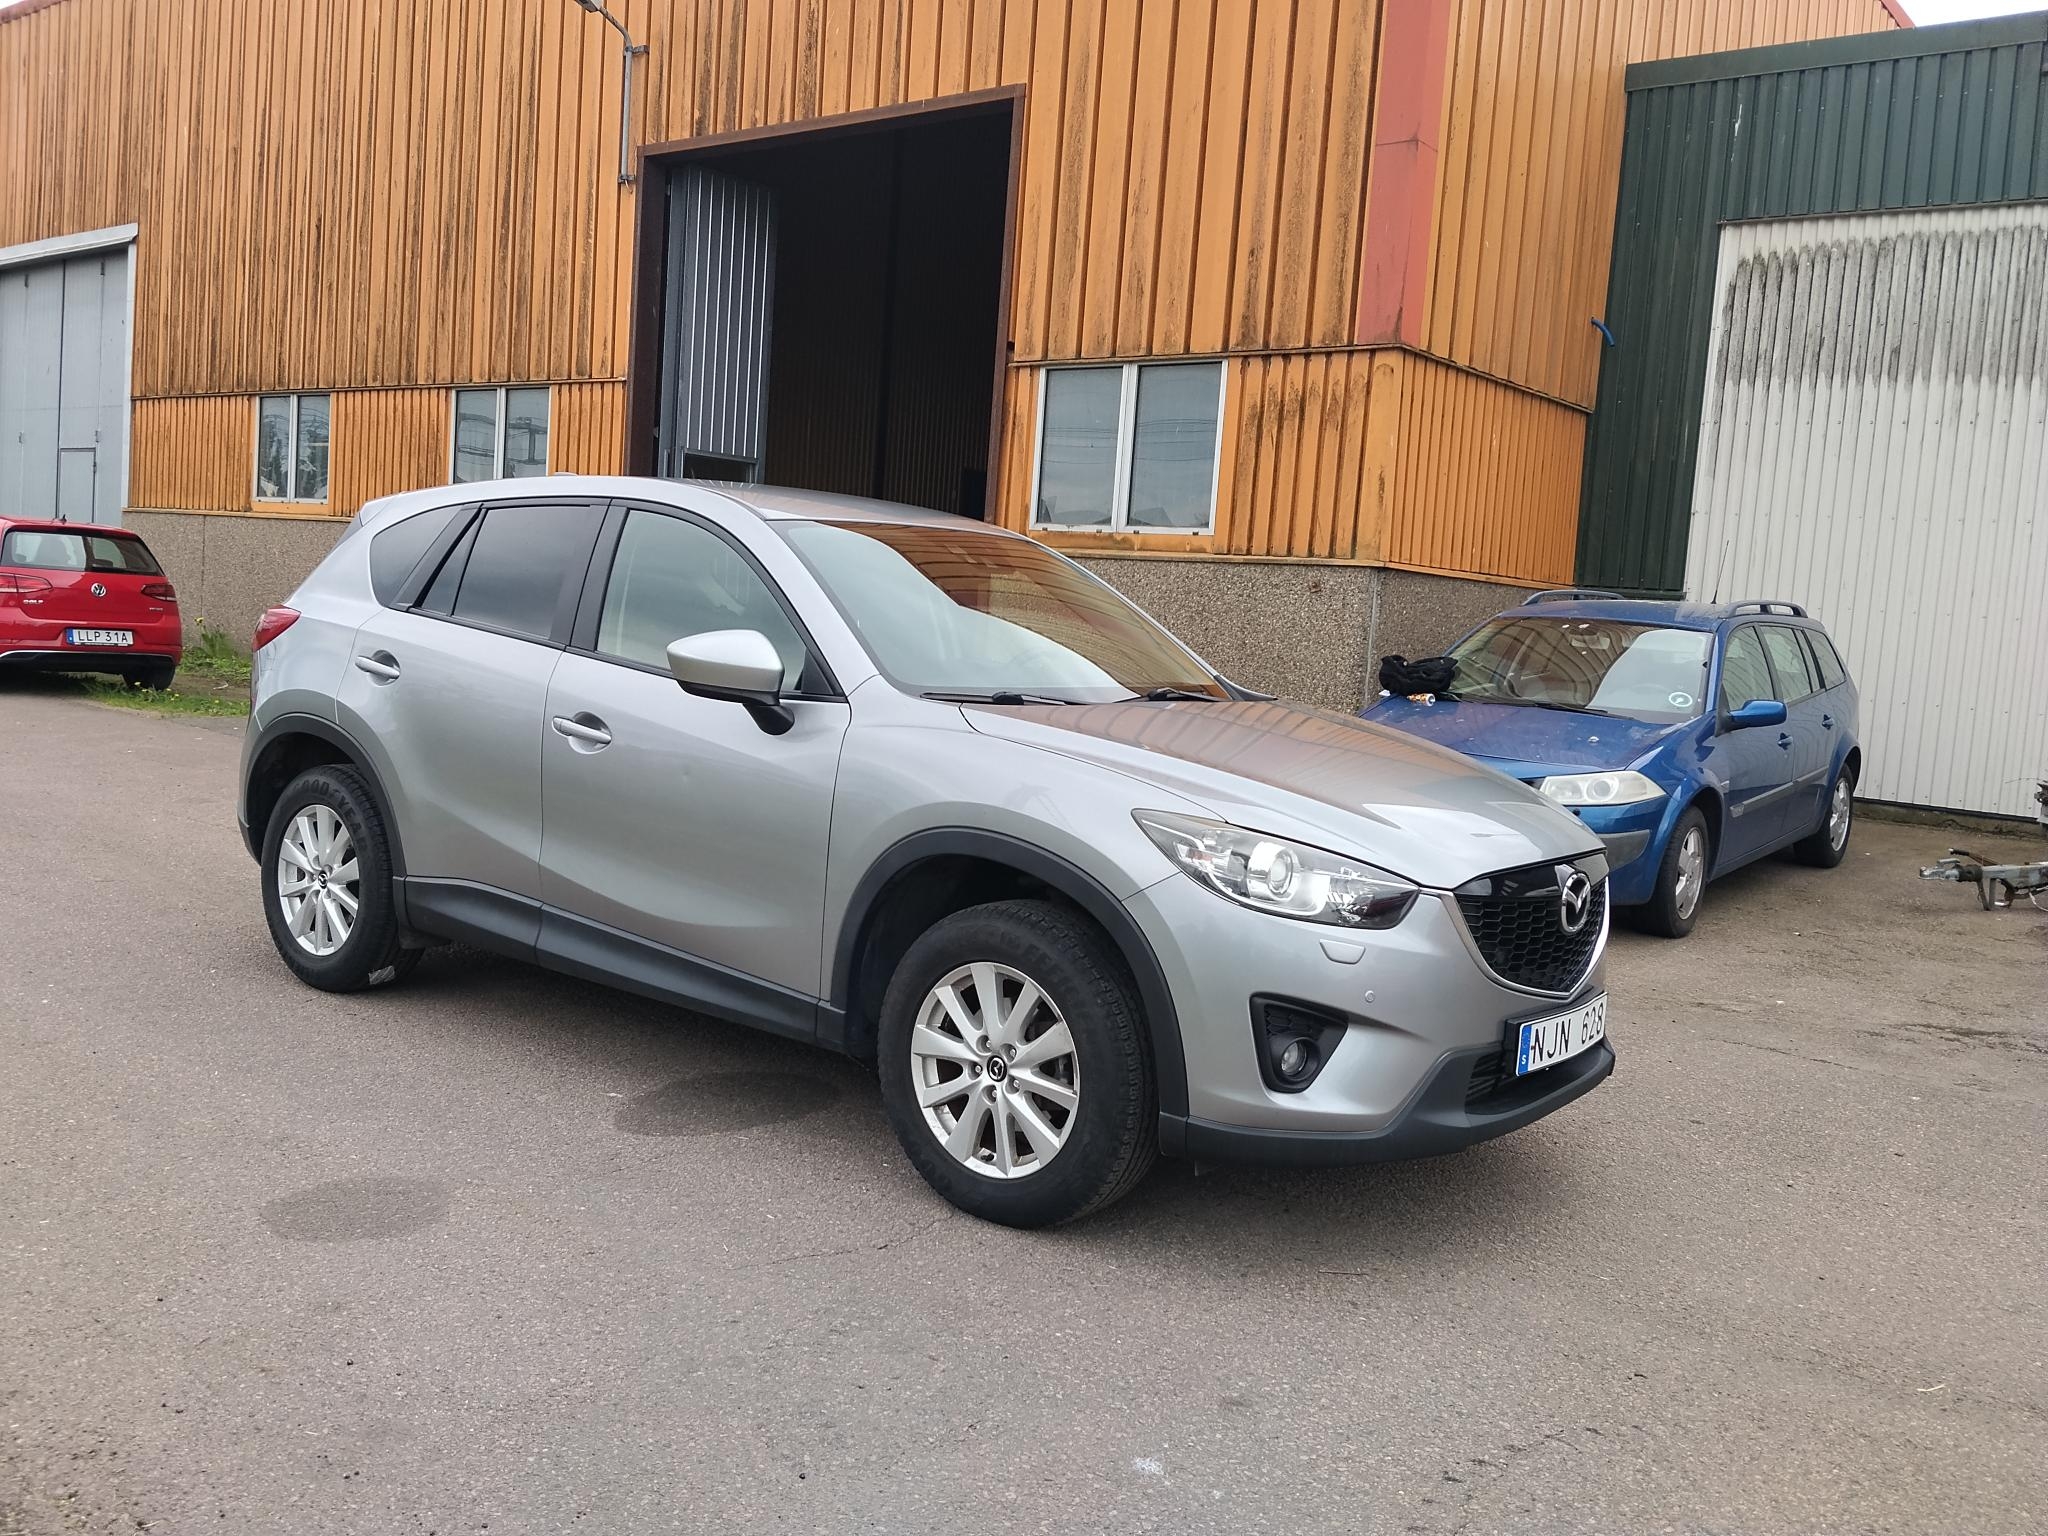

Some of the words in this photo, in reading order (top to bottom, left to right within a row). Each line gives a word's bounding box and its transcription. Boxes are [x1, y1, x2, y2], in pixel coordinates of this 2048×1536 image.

[78, 631, 101, 642] LLP
[105, 631, 128, 643] 31A
[1532, 1018, 1571, 1064] NJN
[1581, 1002, 1604, 1044] 628
[1521, 1054, 1527, 1065] S
